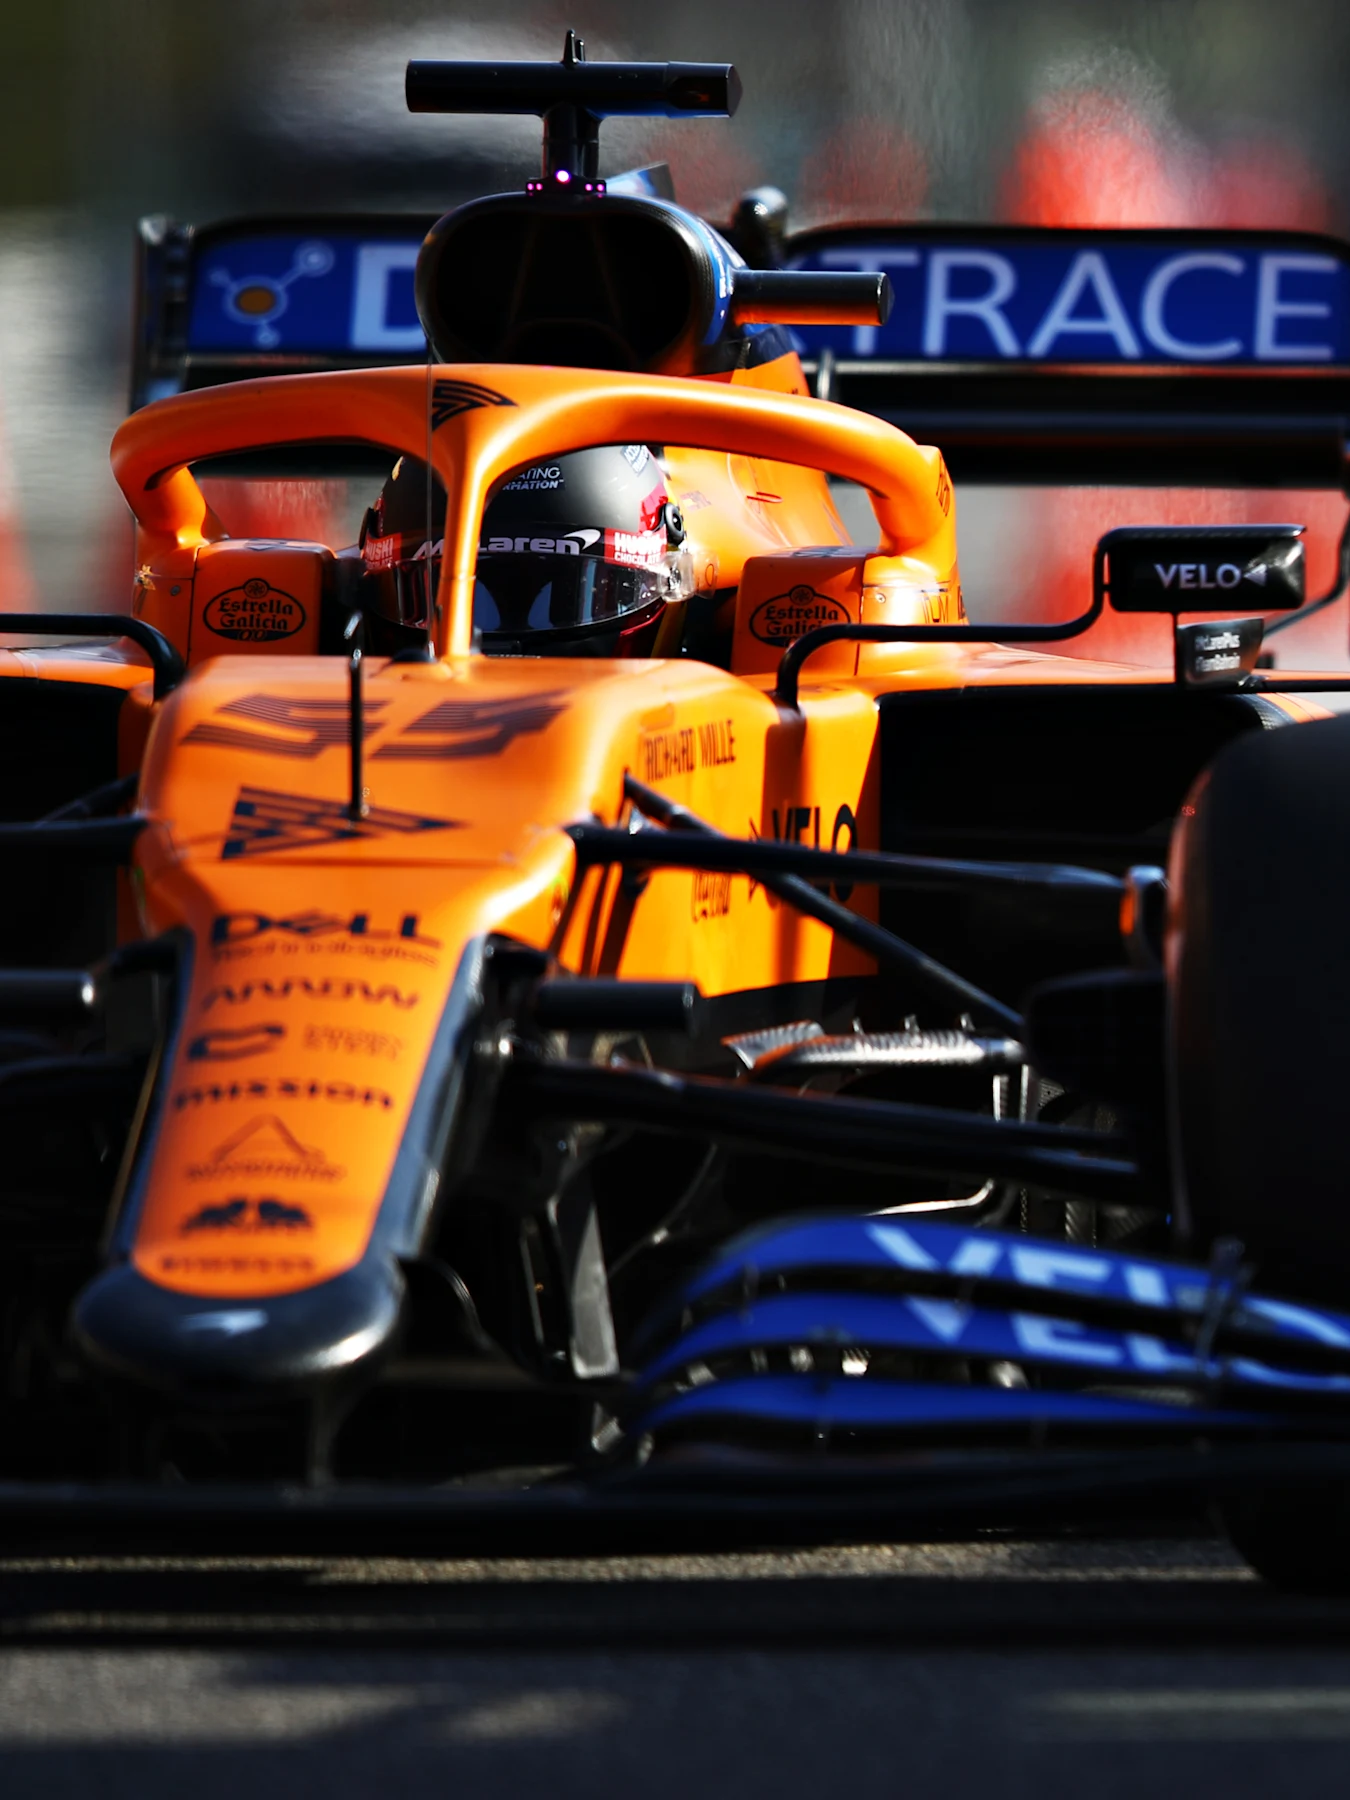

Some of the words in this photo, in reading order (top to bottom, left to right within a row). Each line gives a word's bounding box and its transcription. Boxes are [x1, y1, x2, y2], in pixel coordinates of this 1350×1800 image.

[1154, 563, 1241, 589] VELO
[218, 597, 293, 615] Estrella
[764, 605, 839, 621] Estrella
[220, 613, 288, 630] Galicia
[211, 908, 443, 948] DELL
